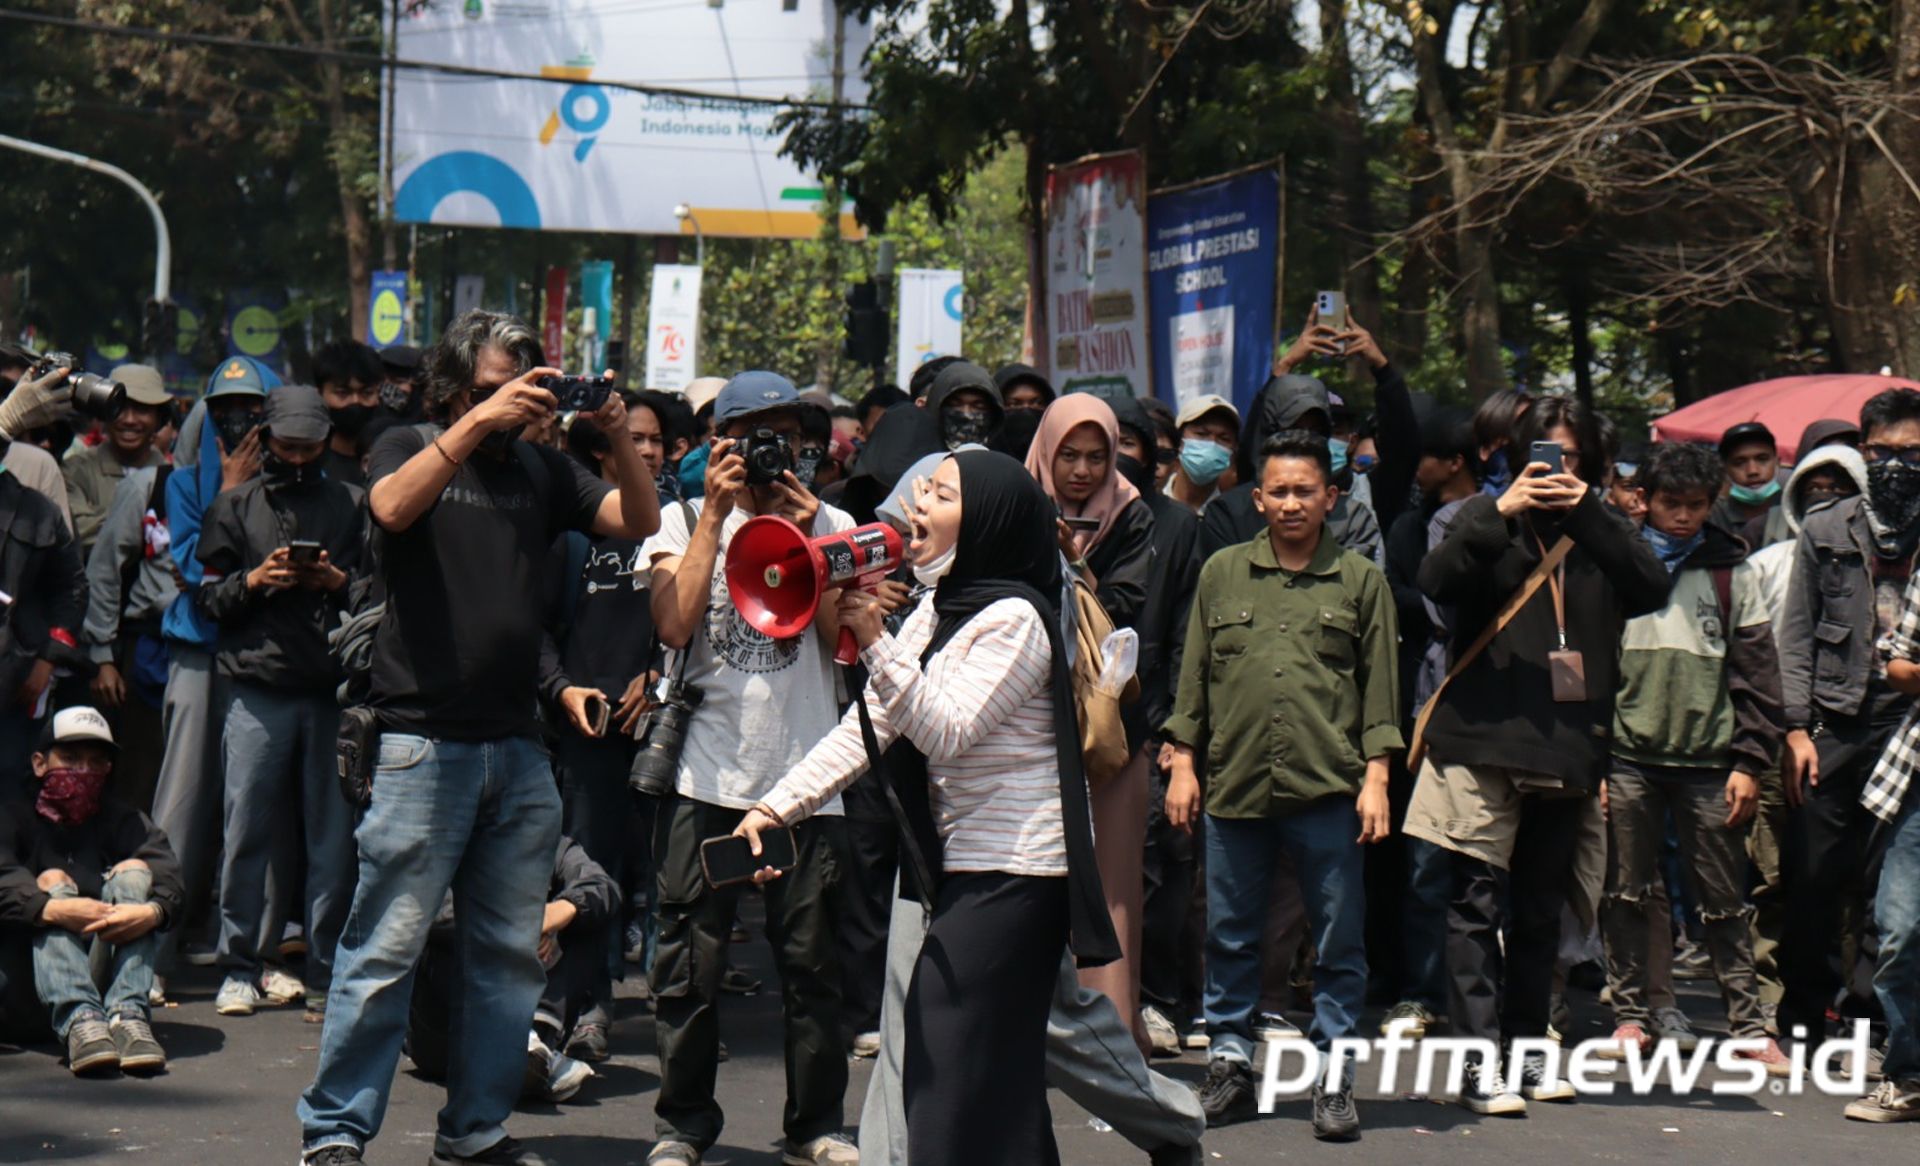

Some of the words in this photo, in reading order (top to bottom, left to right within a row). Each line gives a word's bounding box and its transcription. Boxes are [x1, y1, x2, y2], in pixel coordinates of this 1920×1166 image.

[641, 118, 731, 136] Indonesia
[1149, 241, 1195, 272] GLOBAL
[1197, 226, 1260, 262] PRESTASI
[1175, 265, 1228, 294] SCHOOL
[1075, 328, 1136, 374] FASHION
[738, 648, 754, 666] OF
[758, 649, 779, 666] THE
